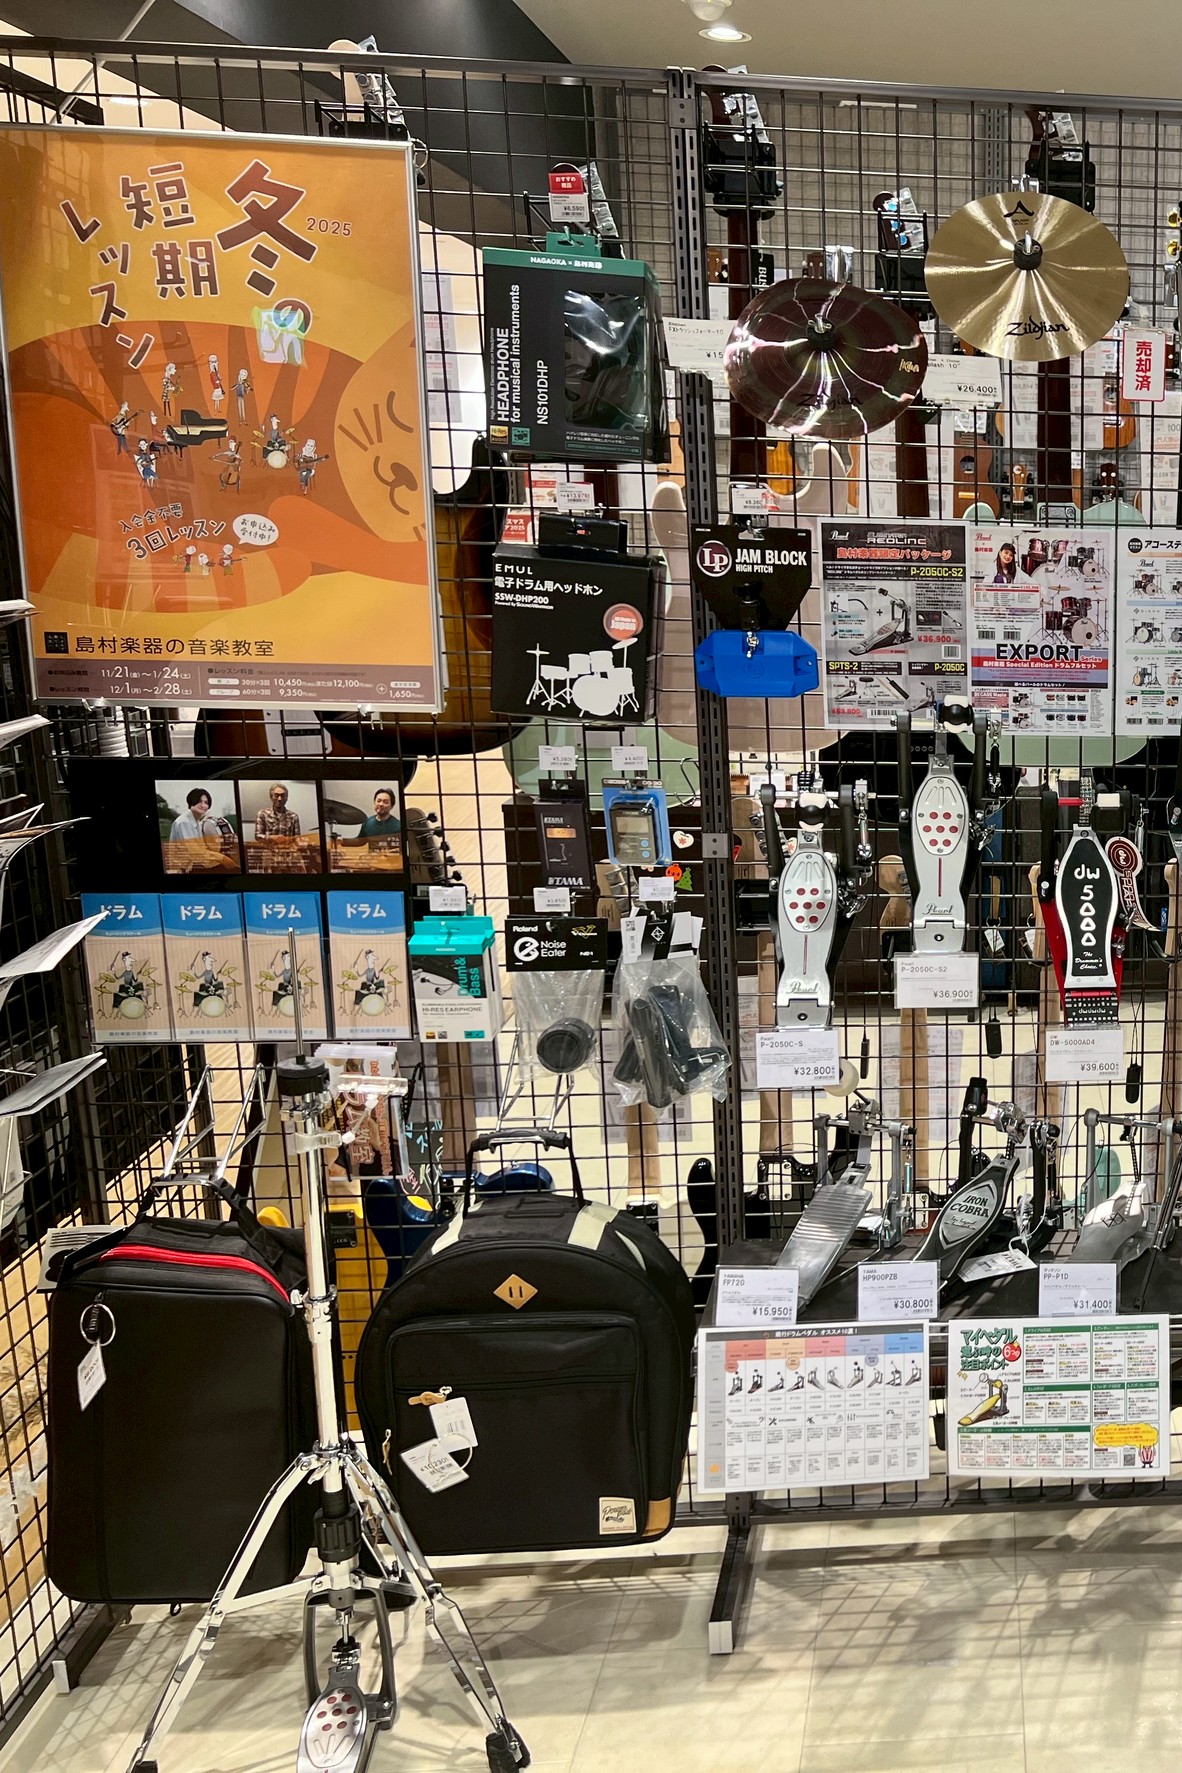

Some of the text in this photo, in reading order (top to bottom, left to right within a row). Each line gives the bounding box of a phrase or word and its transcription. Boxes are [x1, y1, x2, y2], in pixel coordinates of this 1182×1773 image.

[119, 162, 220, 299] 短期
[306, 216, 353, 238] 2025
[530, 256, 567, 266] NAGAOKA
[59, 199, 155, 370] レッスン
[1004, 315, 1071, 340] Zildjian
[510, 284, 521, 424] for musical instruments
[1135, 339, 1153, 392] 売却済
[496, 327, 510, 423] HEADPHONE
[536, 359, 549, 425] NS101DHP
[126, 518, 227, 560] 3回レッスン
[702, 547, 730, 572] LP
[735, 548, 808, 567] JAM BLOCK
[495, 563, 533, 575] EMUL
[735, 564, 774, 573] HIGH PITCH
[910, 566, 965, 577] P-2050C-S2
[494, 576, 604, 596] 電子ドラム用ヘッドホン
[494, 592, 550, 605] SSW-DHP200
[75, 635, 275, 657] 島村楽器の音楽教室
[995, 643, 1084, 662] EXPORT
[1006, 661, 1030, 669] Special
[1030, 661, 1053, 669] Edition
[1074, 864, 1100, 880] dw
[550, 877, 584, 885] TAMA
[180, 904, 224, 921] ドラム
[261, 903, 303, 920] ドラム
[346, 902, 387, 919] ドラム
[922, 903, 955, 916] Pearl
[540, 940, 567, 949] Noise
[540, 949, 567, 957] Eater
[469, 967, 481, 996] Bass
[932, 989, 971, 999] ¥36,900
[793, 1065, 833, 1077] ¥32,800
[1080, 1062, 1117, 1072] ¥39,600
[962, 1194, 990, 1207] IRON
[949, 1202, 990, 1219] COBRA
[722, 1278, 746, 1287] FP720
[1043, 1272, 1069, 1281] PP-P1D
[752, 1306, 790, 1317] ¥15,950
[893, 1299, 930, 1310] ¥30,800
[1073, 1299, 1110, 1310] ¥31,400
